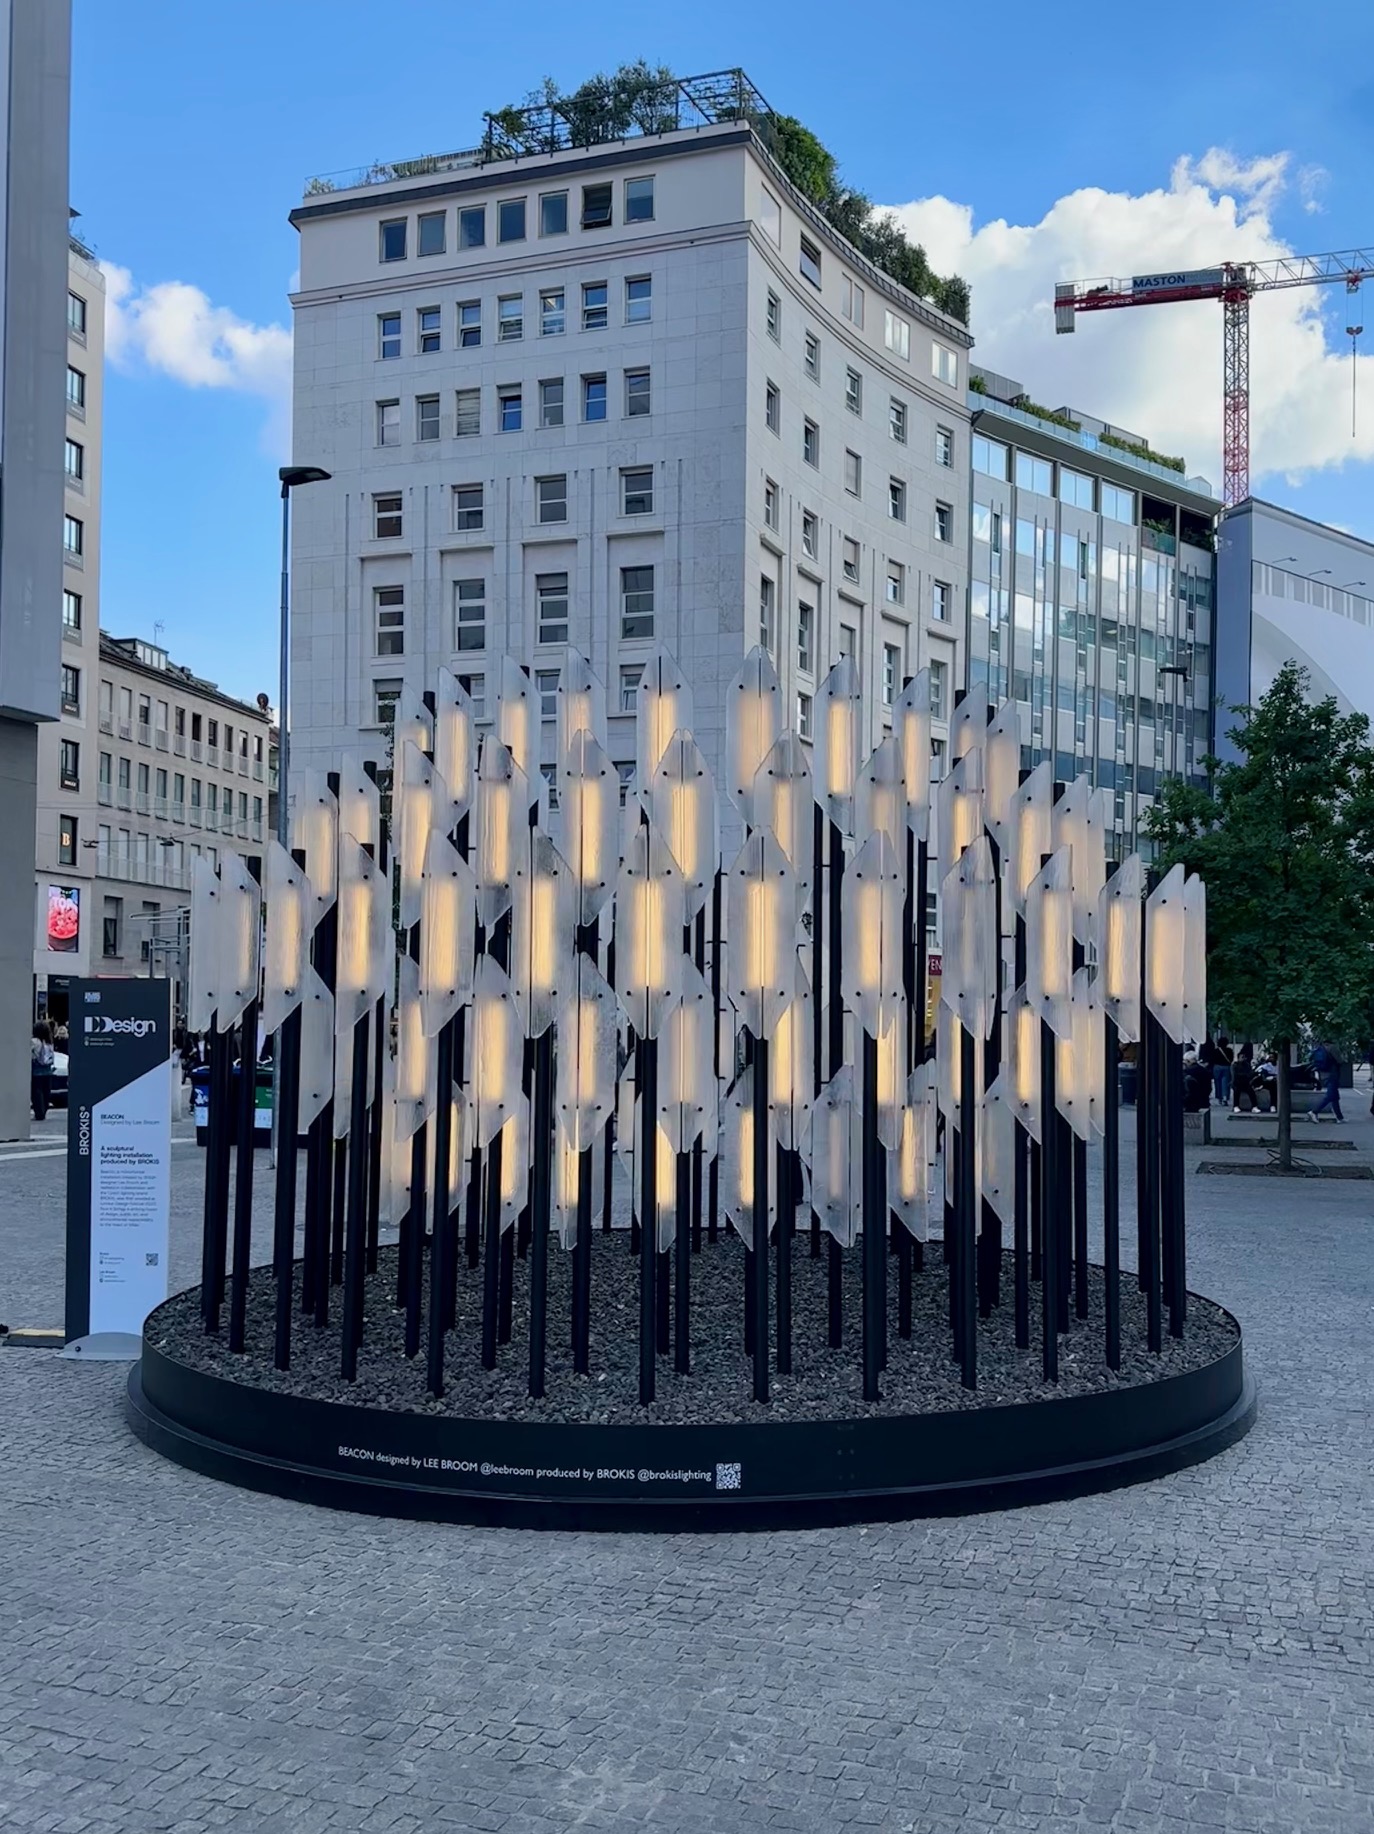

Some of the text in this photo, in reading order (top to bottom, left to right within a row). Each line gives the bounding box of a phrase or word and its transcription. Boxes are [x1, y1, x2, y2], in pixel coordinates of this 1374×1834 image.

[1133, 275, 1186, 289] MASTON
[338, 1446, 712, 1483] BEACON designed by LEE BROOM @leebroom produced by BROKIS @brokislighting
